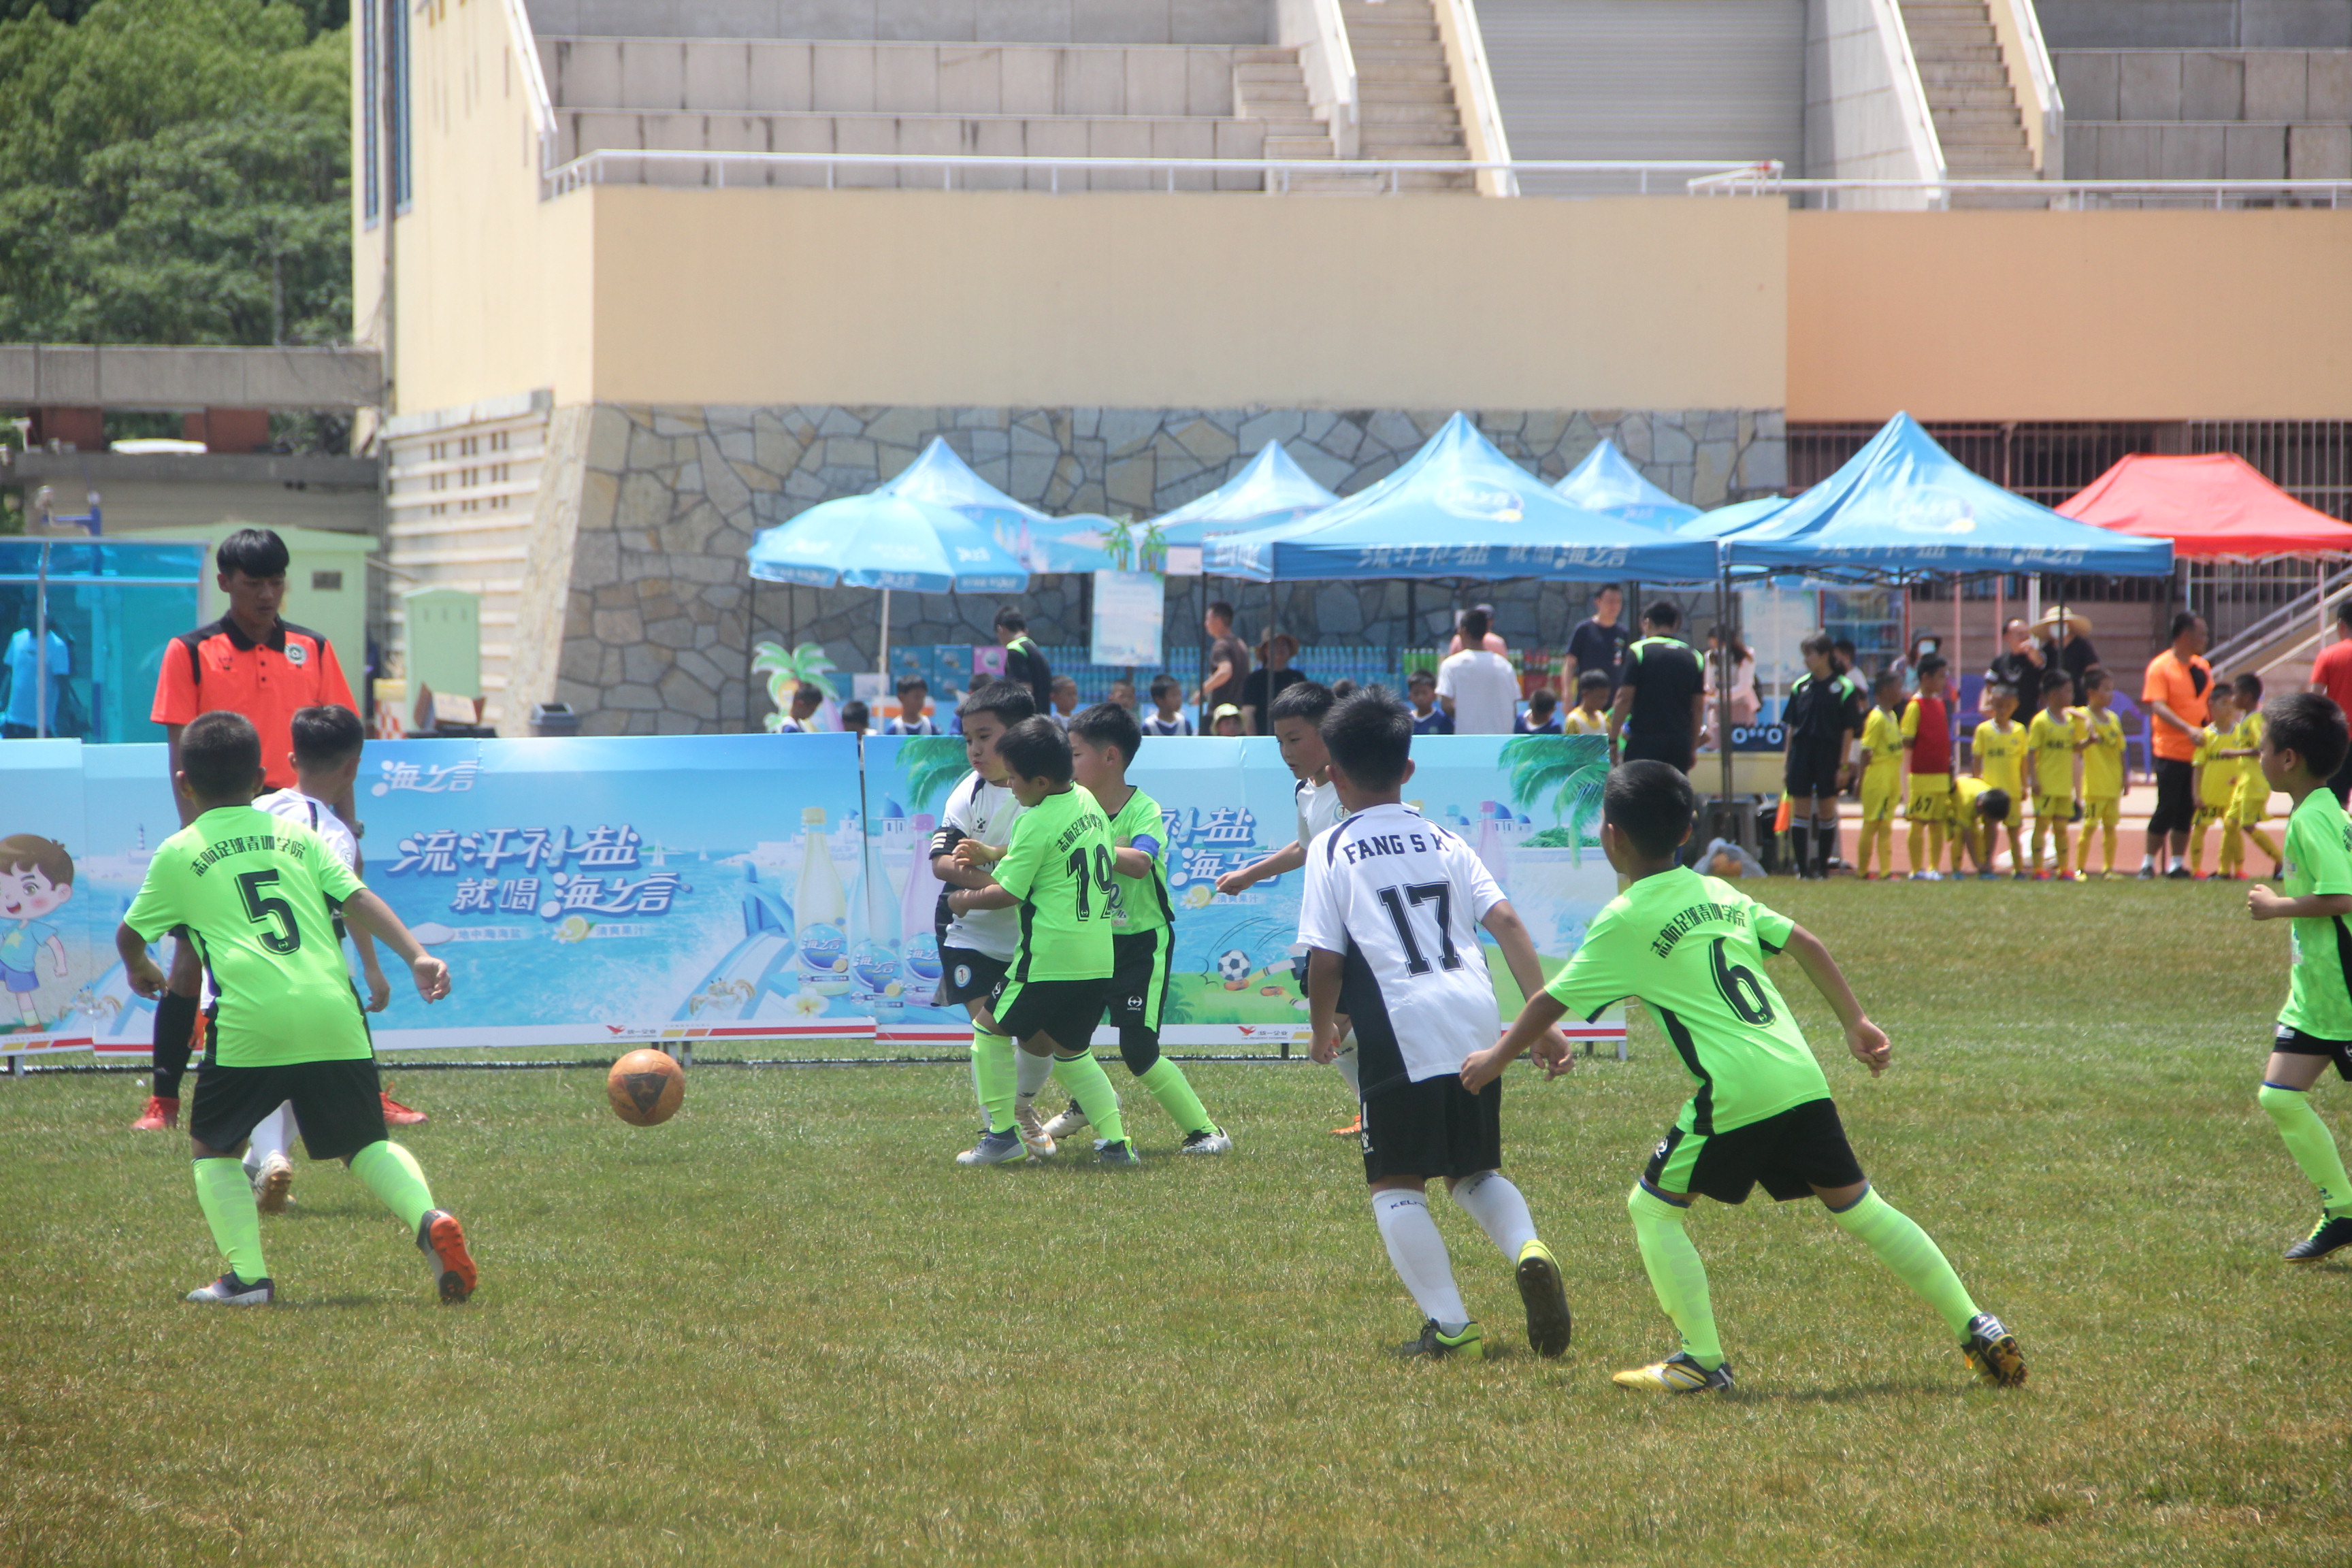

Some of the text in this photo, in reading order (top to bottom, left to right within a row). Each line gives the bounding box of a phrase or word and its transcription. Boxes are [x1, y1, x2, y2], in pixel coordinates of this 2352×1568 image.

[371, 760, 480, 797] 海之言
[190, 835, 306, 877] 志航足球青训学院
[386, 823, 640, 874] 流汗补盐
[1343, 832, 1450, 865] FANG S K
[451, 871, 681, 918] 就喝海之言
[1066, 843, 1113, 921] 19
[234, 868, 301, 956] 5
[1376, 881, 1464, 977] 17
[1650, 902, 1747, 959] 志航足球青训学院
[800, 937, 845, 951] 海之言
[1708, 937, 1776, 1028] 6
